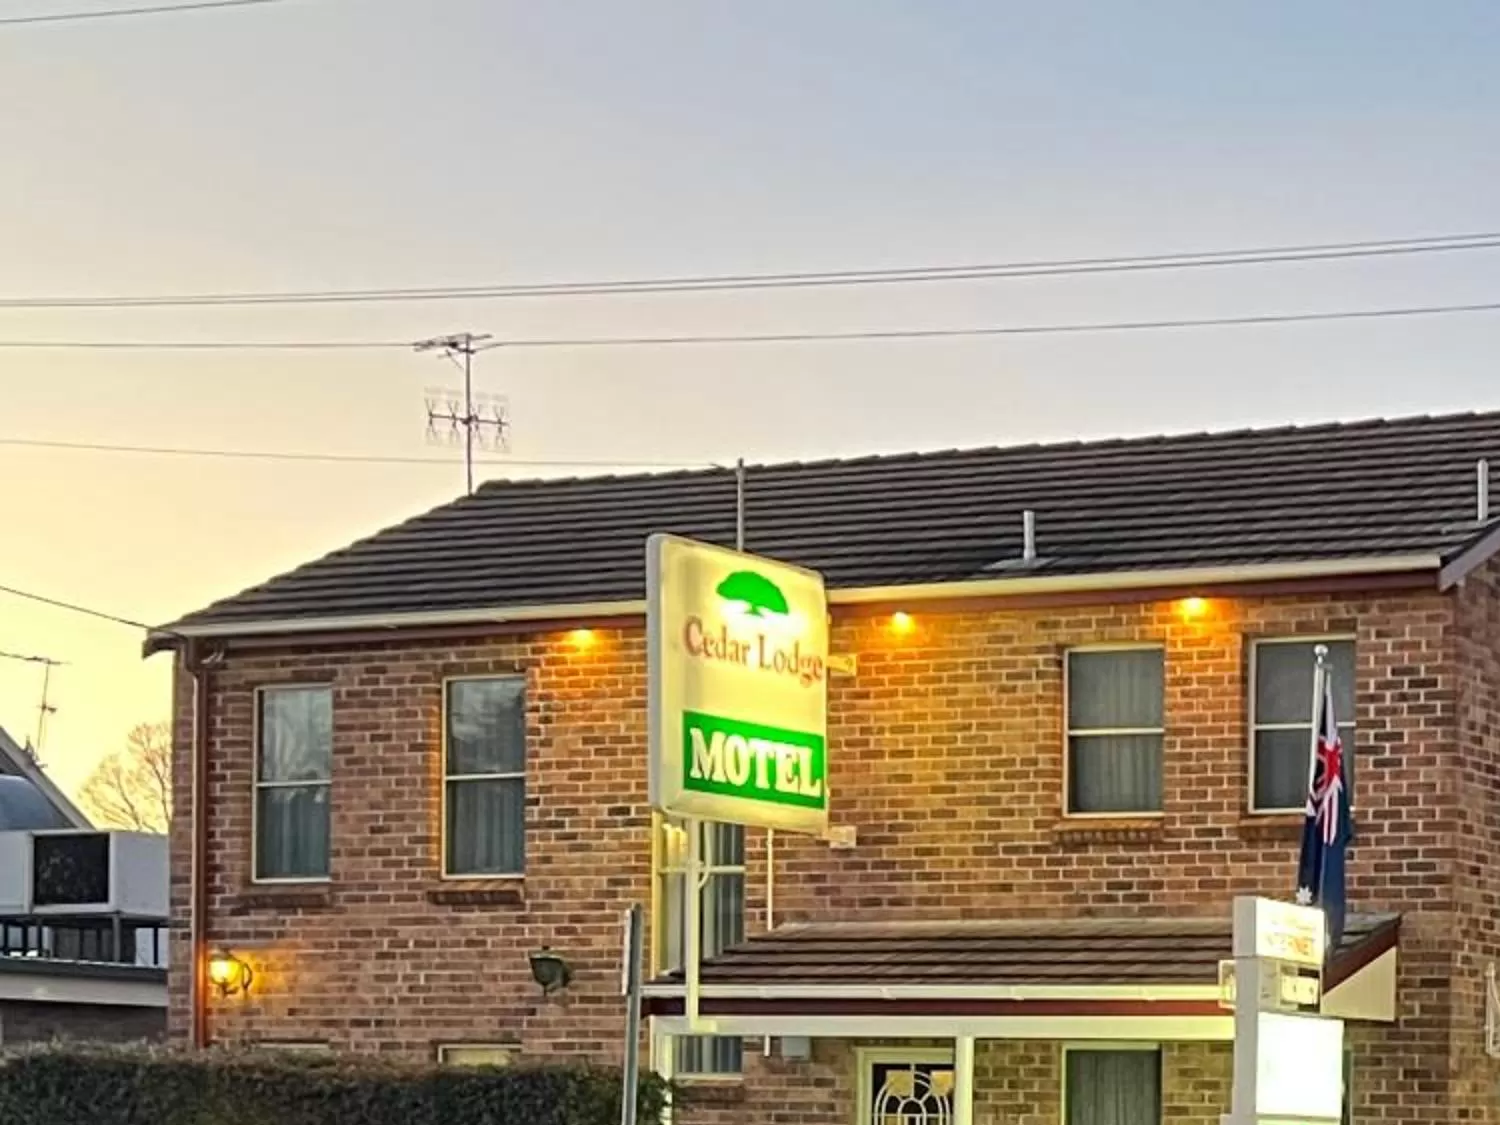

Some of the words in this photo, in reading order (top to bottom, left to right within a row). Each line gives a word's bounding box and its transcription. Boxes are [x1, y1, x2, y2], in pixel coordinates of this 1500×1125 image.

[682, 615, 751, 666] Cedar
[758, 633, 823, 687] Lodge
[689, 727, 822, 798] MOTEL
